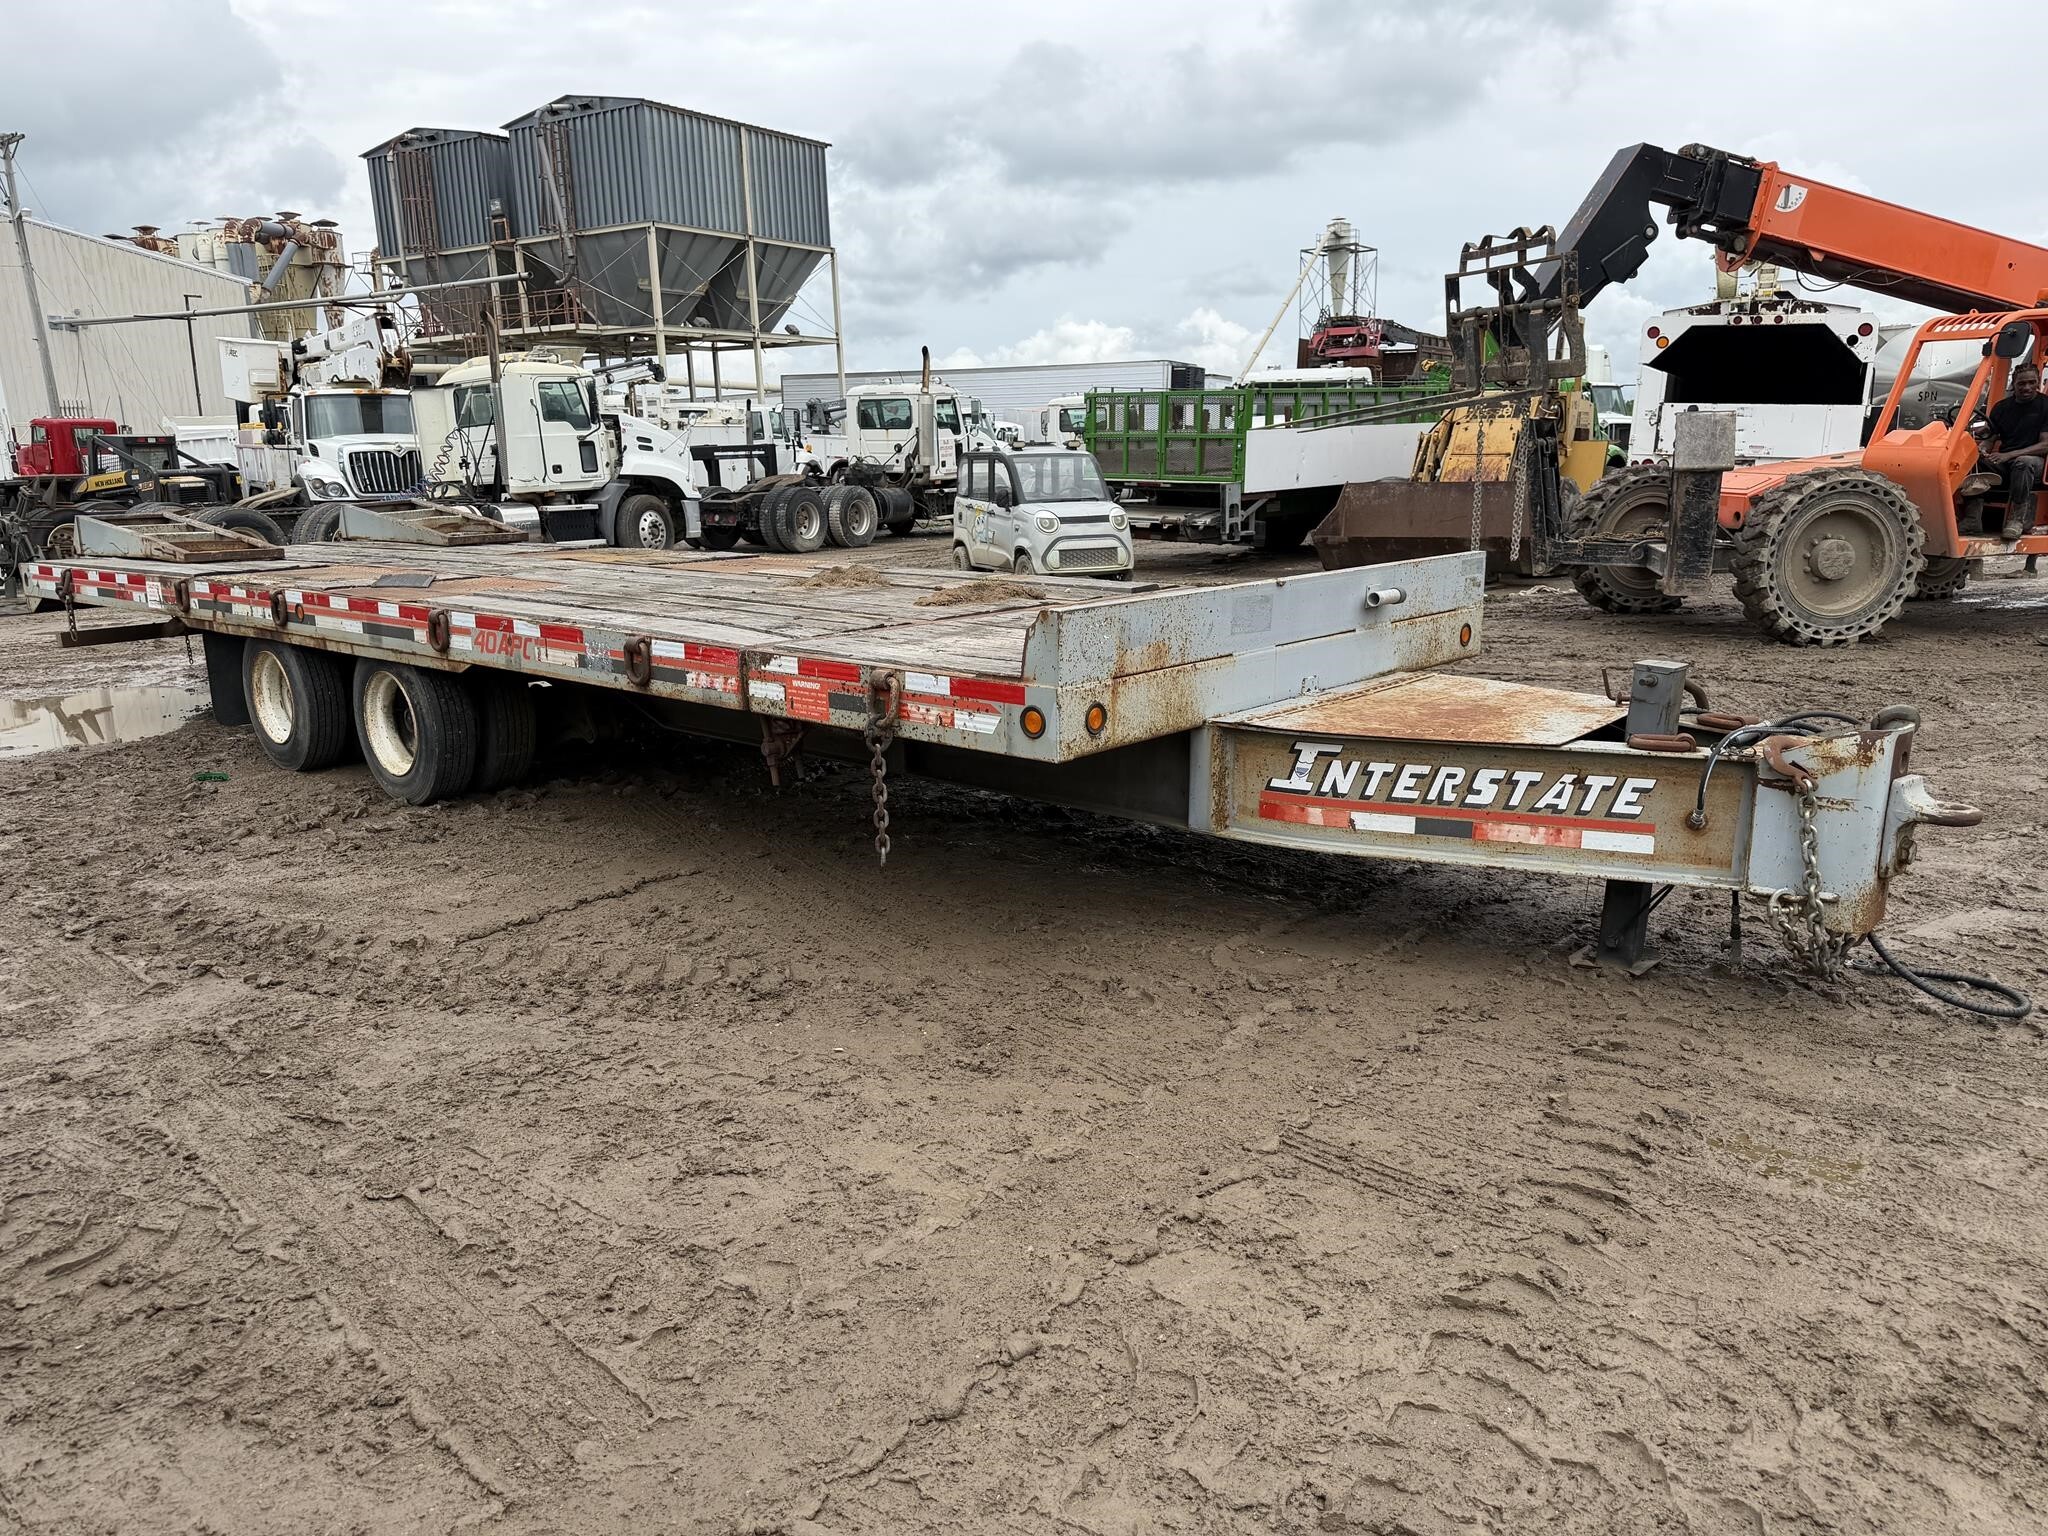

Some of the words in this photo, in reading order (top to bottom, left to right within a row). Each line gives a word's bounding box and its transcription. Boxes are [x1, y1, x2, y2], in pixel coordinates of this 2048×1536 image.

[1918, 391, 1938, 401] SPN
[105, 477, 123, 486] HOLLAND
[1267, 741, 1657, 819] INTERSTATE
